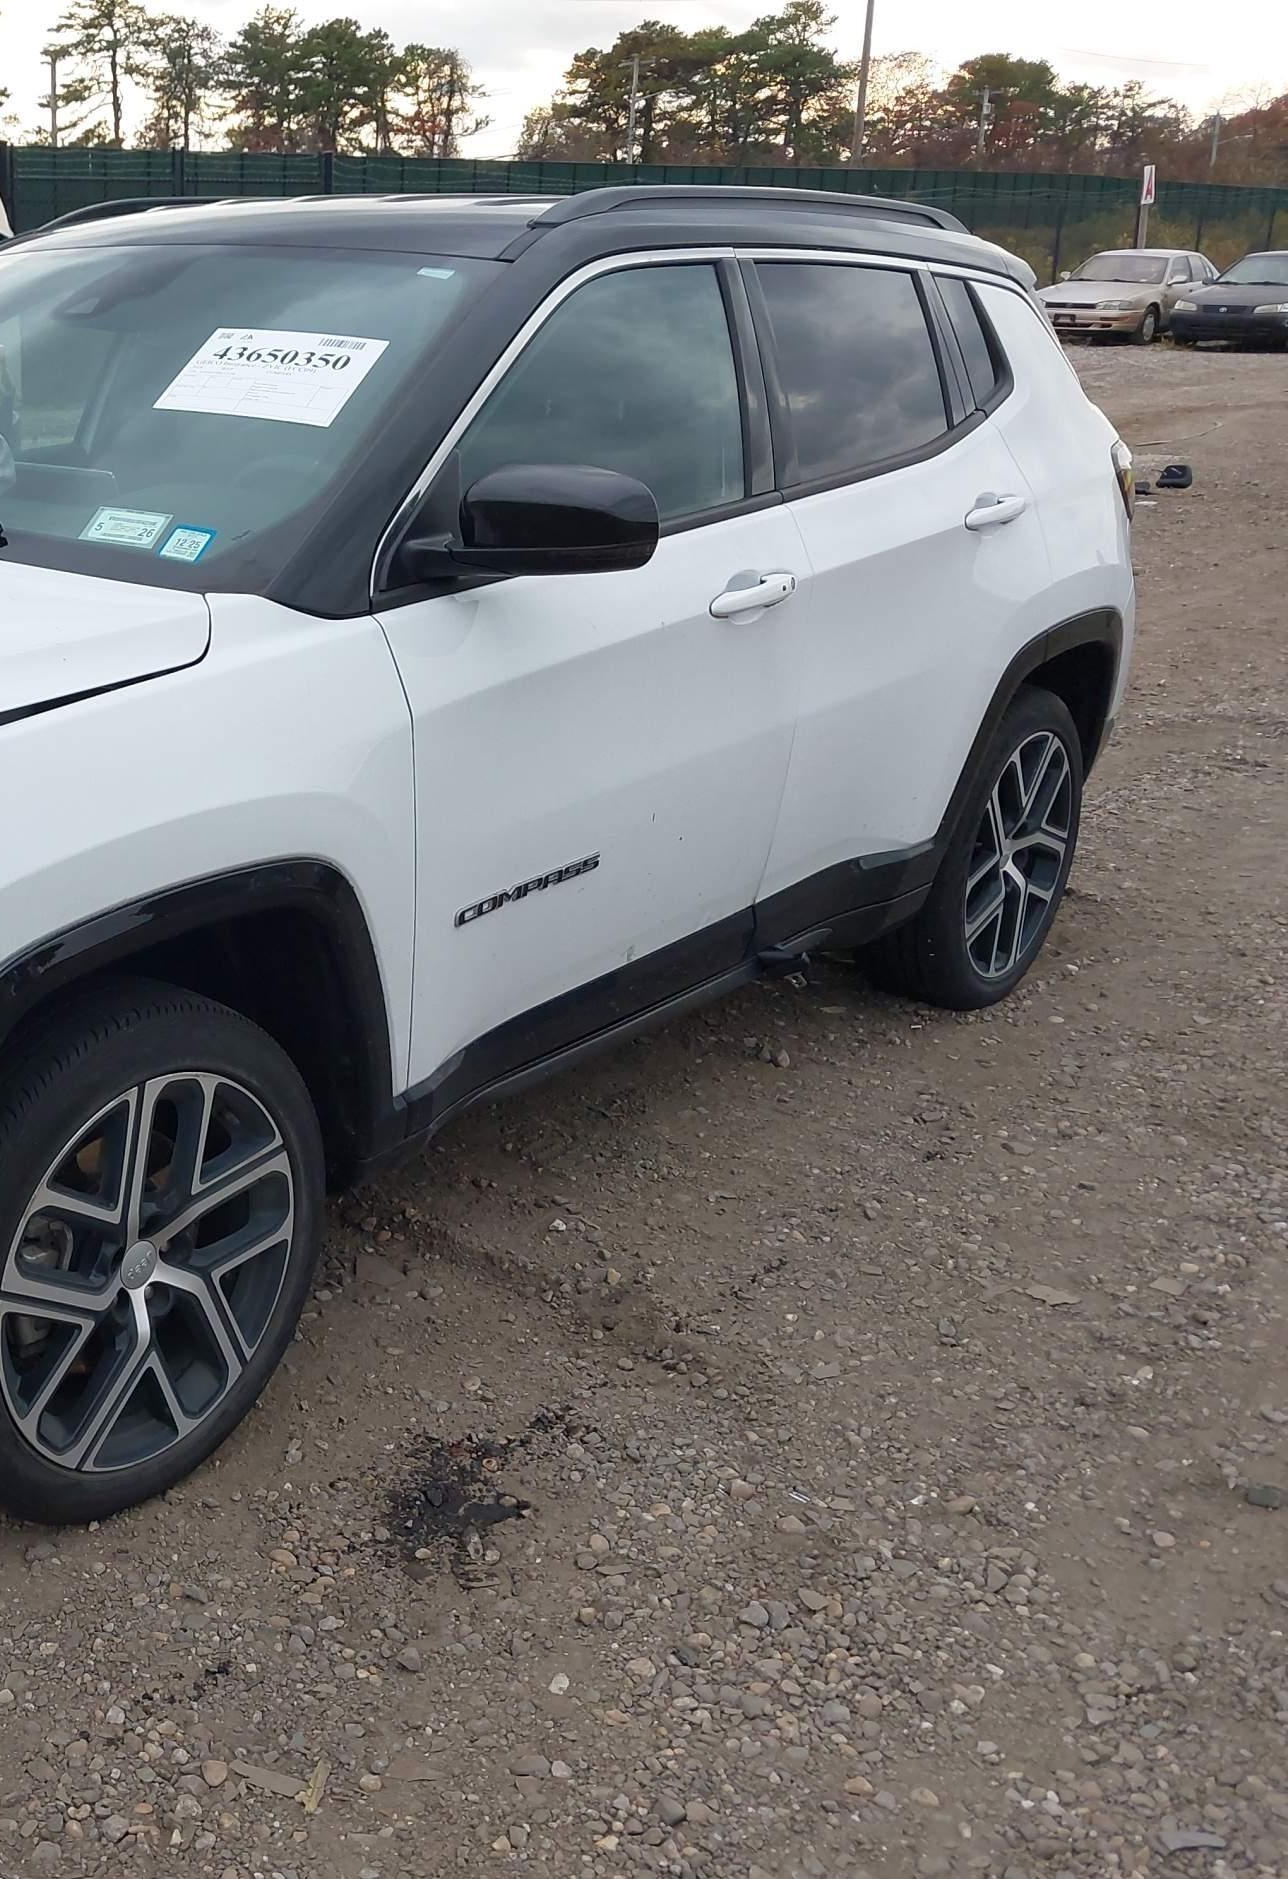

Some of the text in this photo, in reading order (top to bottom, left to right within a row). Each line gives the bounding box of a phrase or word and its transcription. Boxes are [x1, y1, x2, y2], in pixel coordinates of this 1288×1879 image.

[212, 344, 352, 371] 43650350
[94, 522, 105, 532] 5
[137, 528, 156, 538] 26
[454, 850, 601, 928] COMPASS
